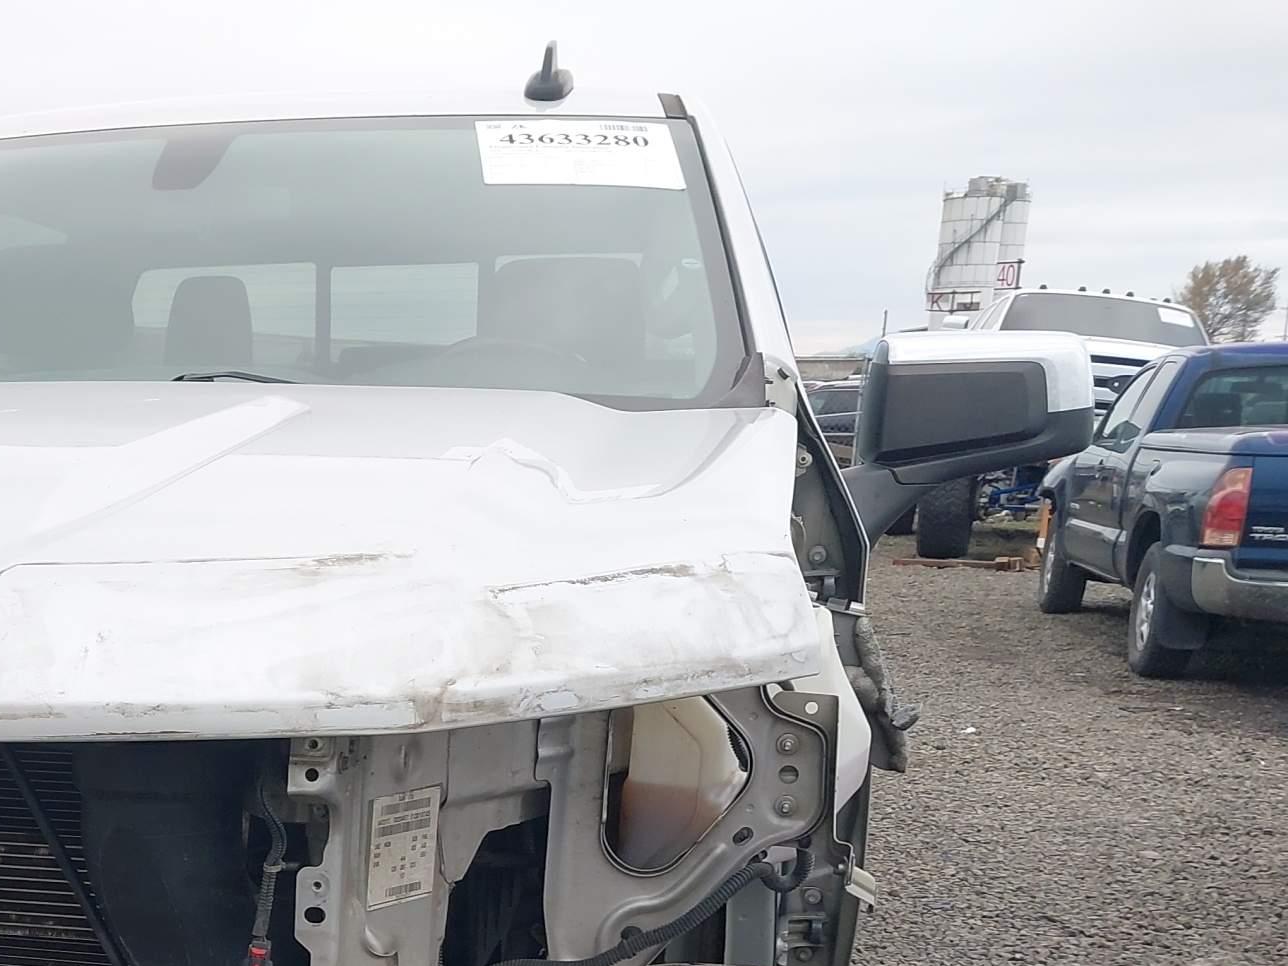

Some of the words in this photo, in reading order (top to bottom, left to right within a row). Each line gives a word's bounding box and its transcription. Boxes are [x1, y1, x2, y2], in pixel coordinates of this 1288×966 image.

[499, 133, 649, 147] 43633280
[997, 264, 1016, 287] 40
[930, 294, 942, 311] K
